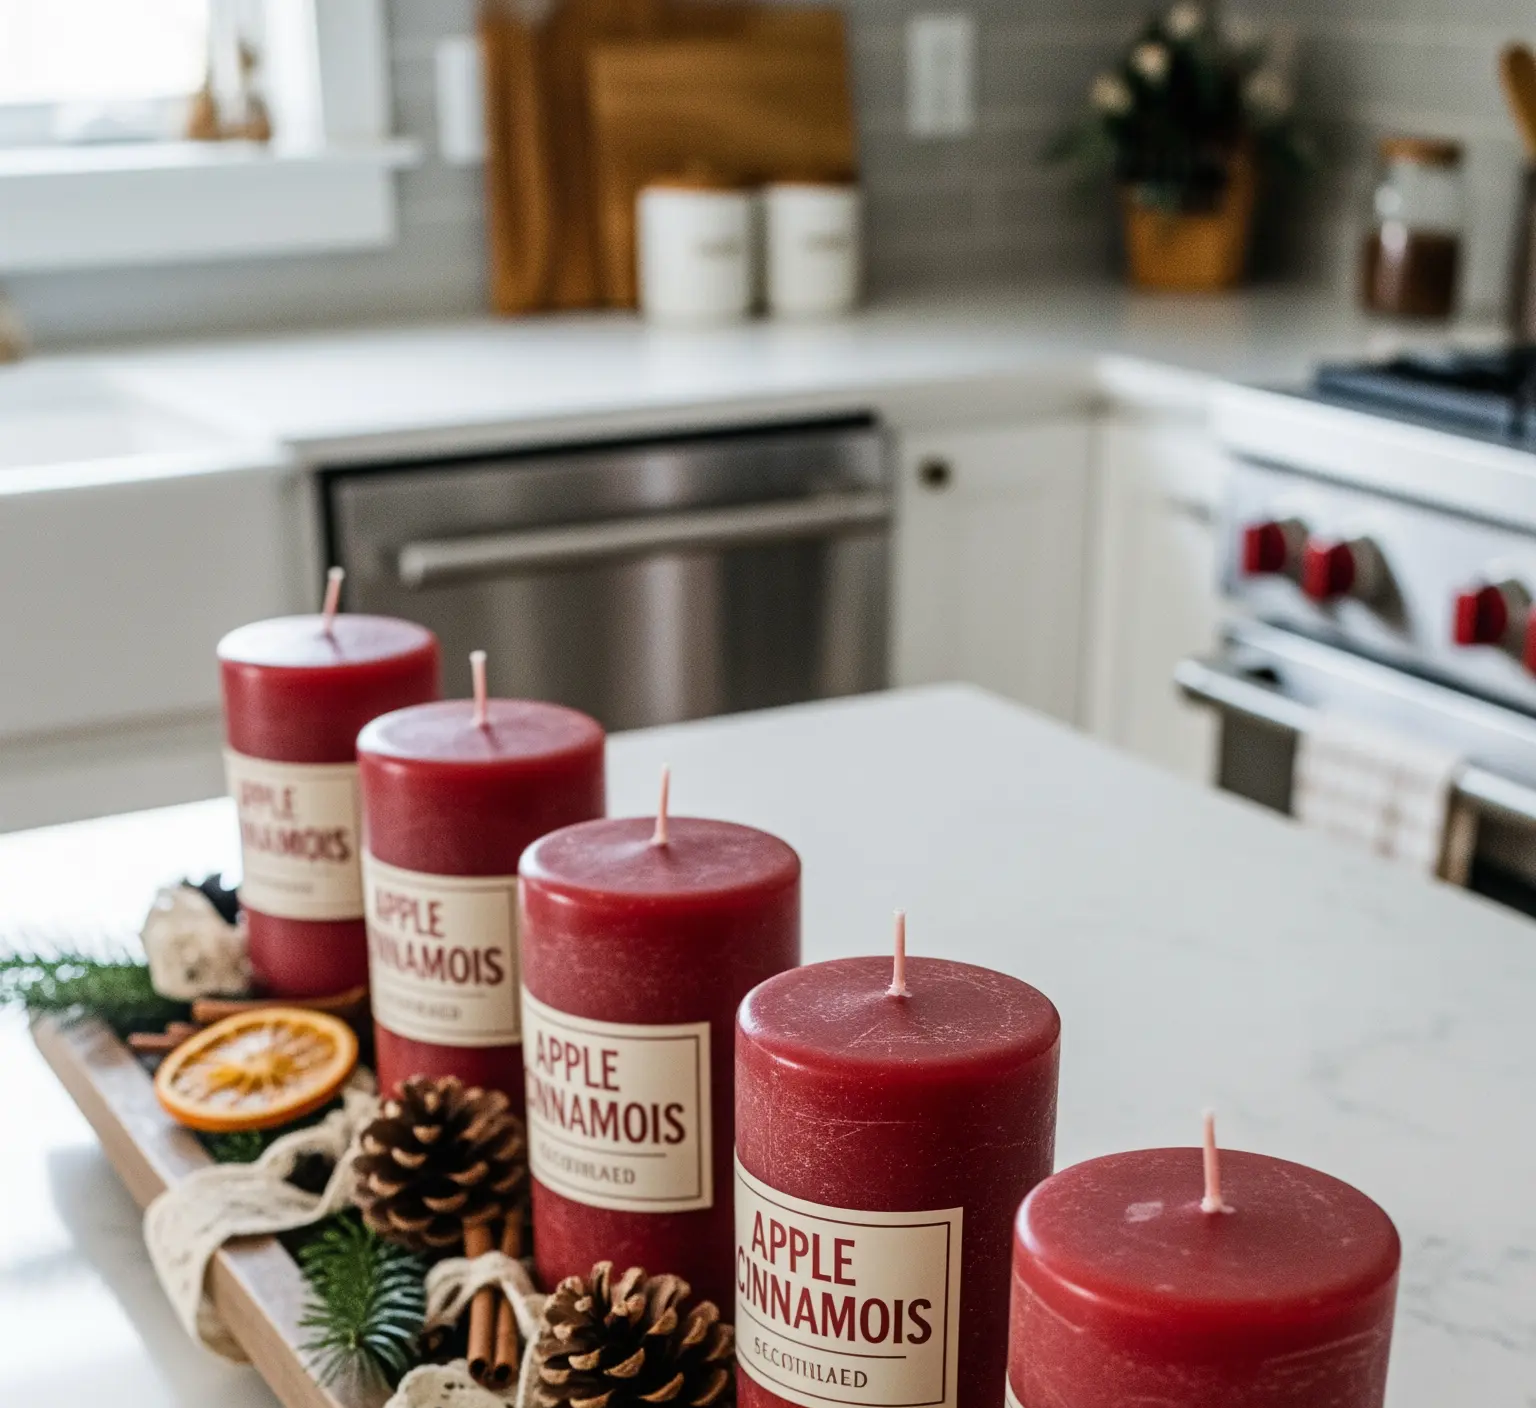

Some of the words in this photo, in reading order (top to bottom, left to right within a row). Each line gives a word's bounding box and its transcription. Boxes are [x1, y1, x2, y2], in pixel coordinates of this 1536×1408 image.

[371, 931, 504, 986] NAMOIS
[536, 1030, 621, 1092] APPLE
[526, 1067, 686, 1145] NNAMOIS
[752, 1210, 857, 1287] APPLE
[737, 1245, 932, 1345] CINNAMOIS
